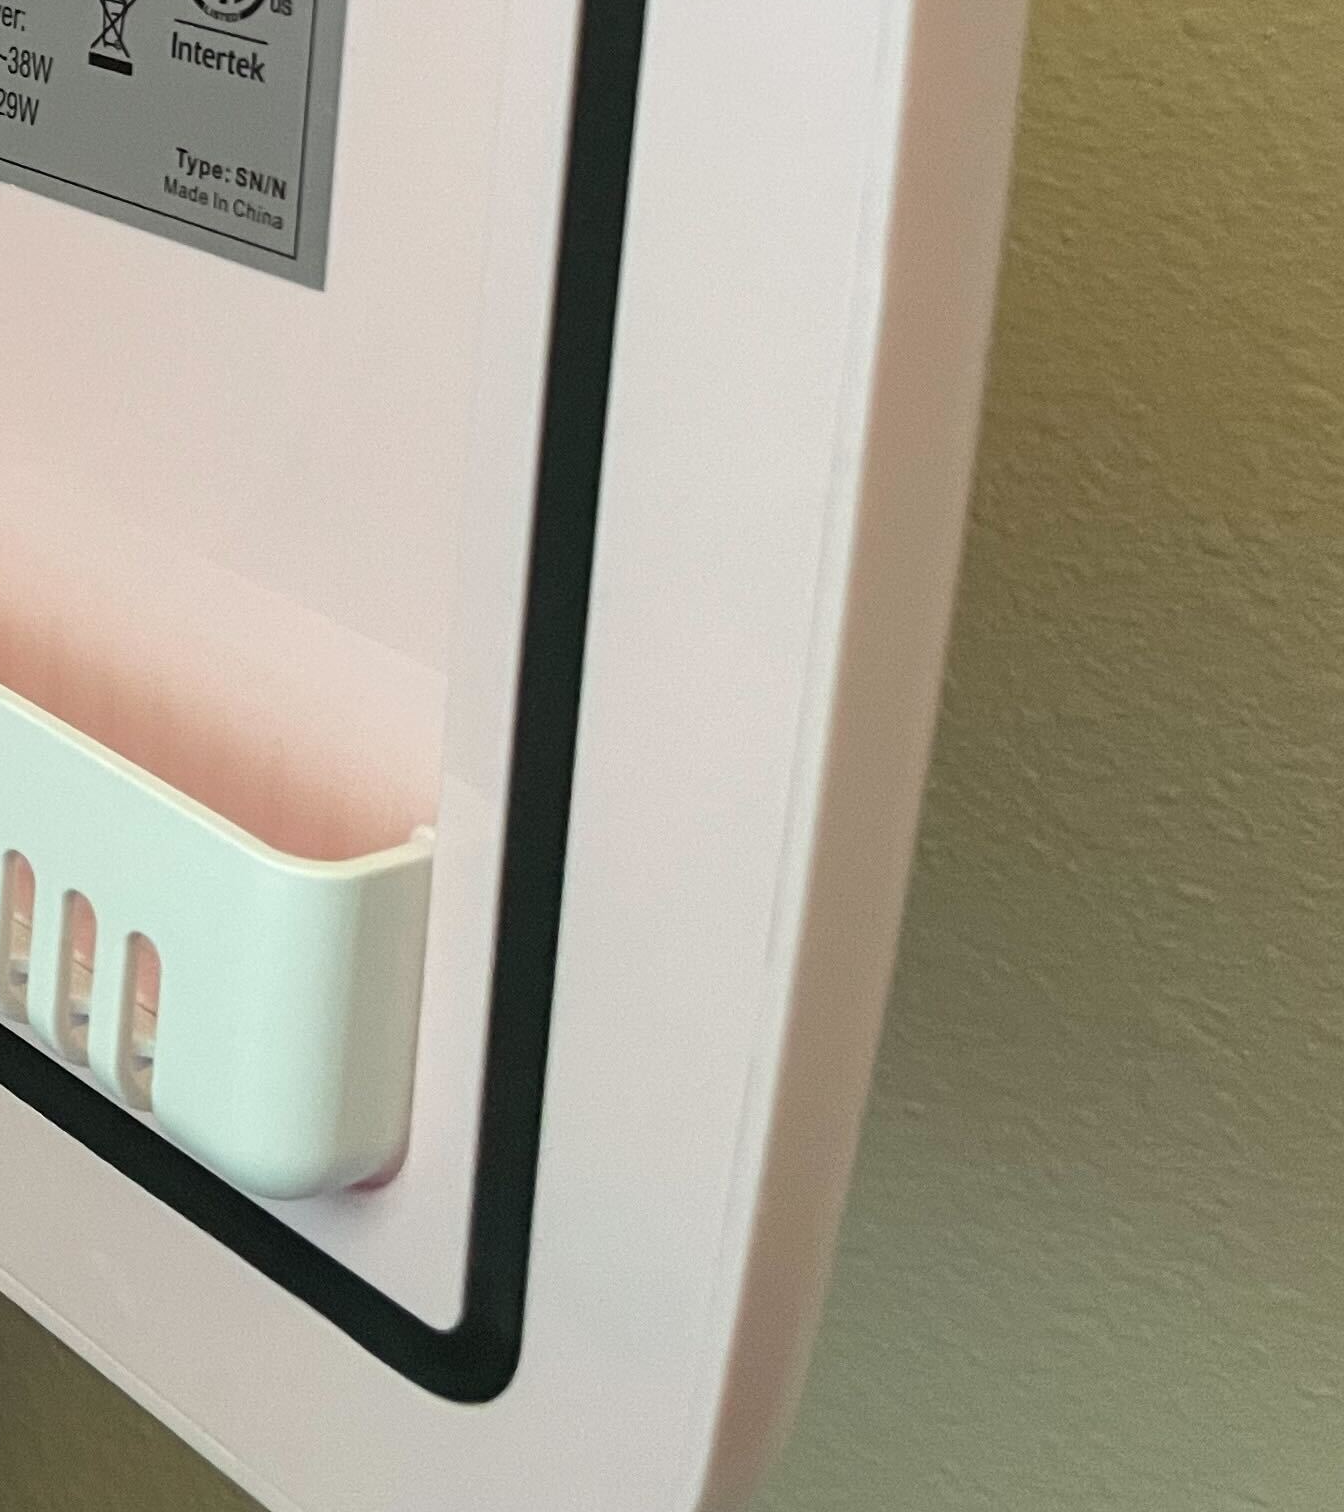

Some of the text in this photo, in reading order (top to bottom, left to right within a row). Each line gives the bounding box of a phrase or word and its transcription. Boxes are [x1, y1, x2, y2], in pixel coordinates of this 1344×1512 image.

[170, 31, 266, 84] Intertek
[176, 146, 288, 200] Type: SN/N
[164, 175, 208, 207] Made
[233, 197, 284, 231] China
